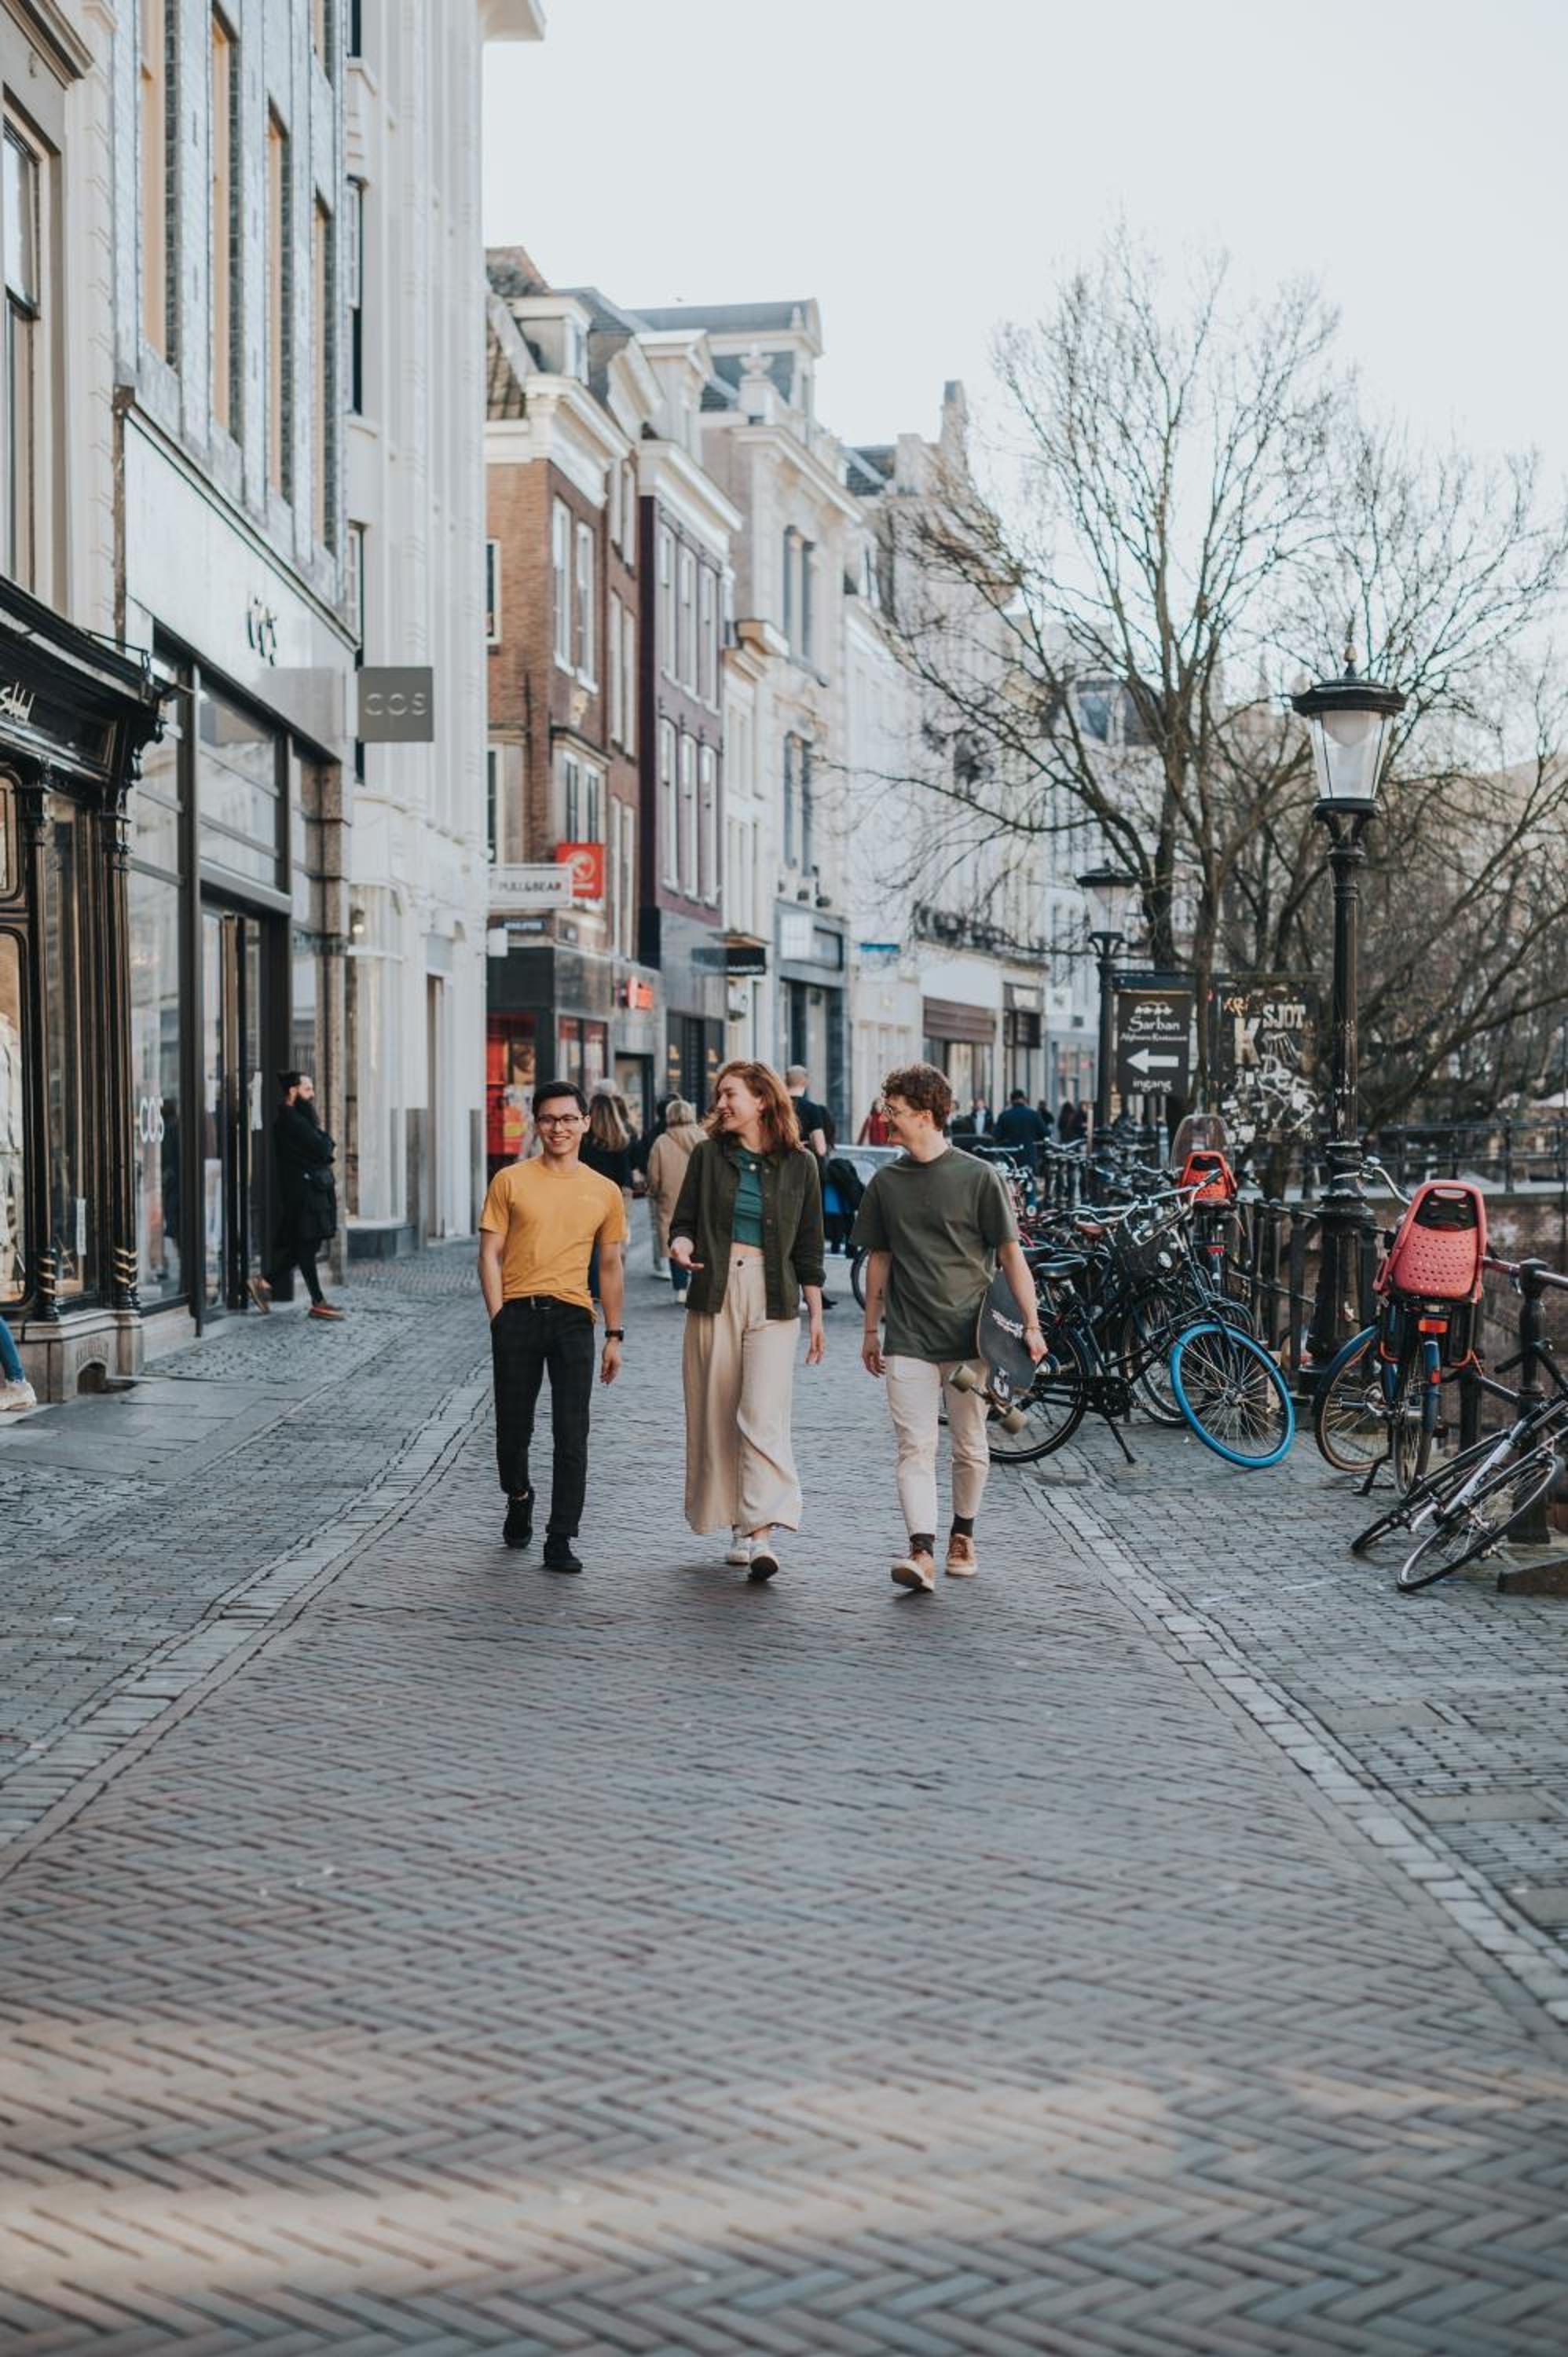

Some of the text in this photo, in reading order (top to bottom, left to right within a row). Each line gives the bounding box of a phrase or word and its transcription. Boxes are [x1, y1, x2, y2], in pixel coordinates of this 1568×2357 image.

[364, 692, 427, 717] COS
[1128, 1016, 1180, 1033] Sarban
[1132, 1077, 1172, 1093] ingang
[139, 1095, 165, 1143] COS
